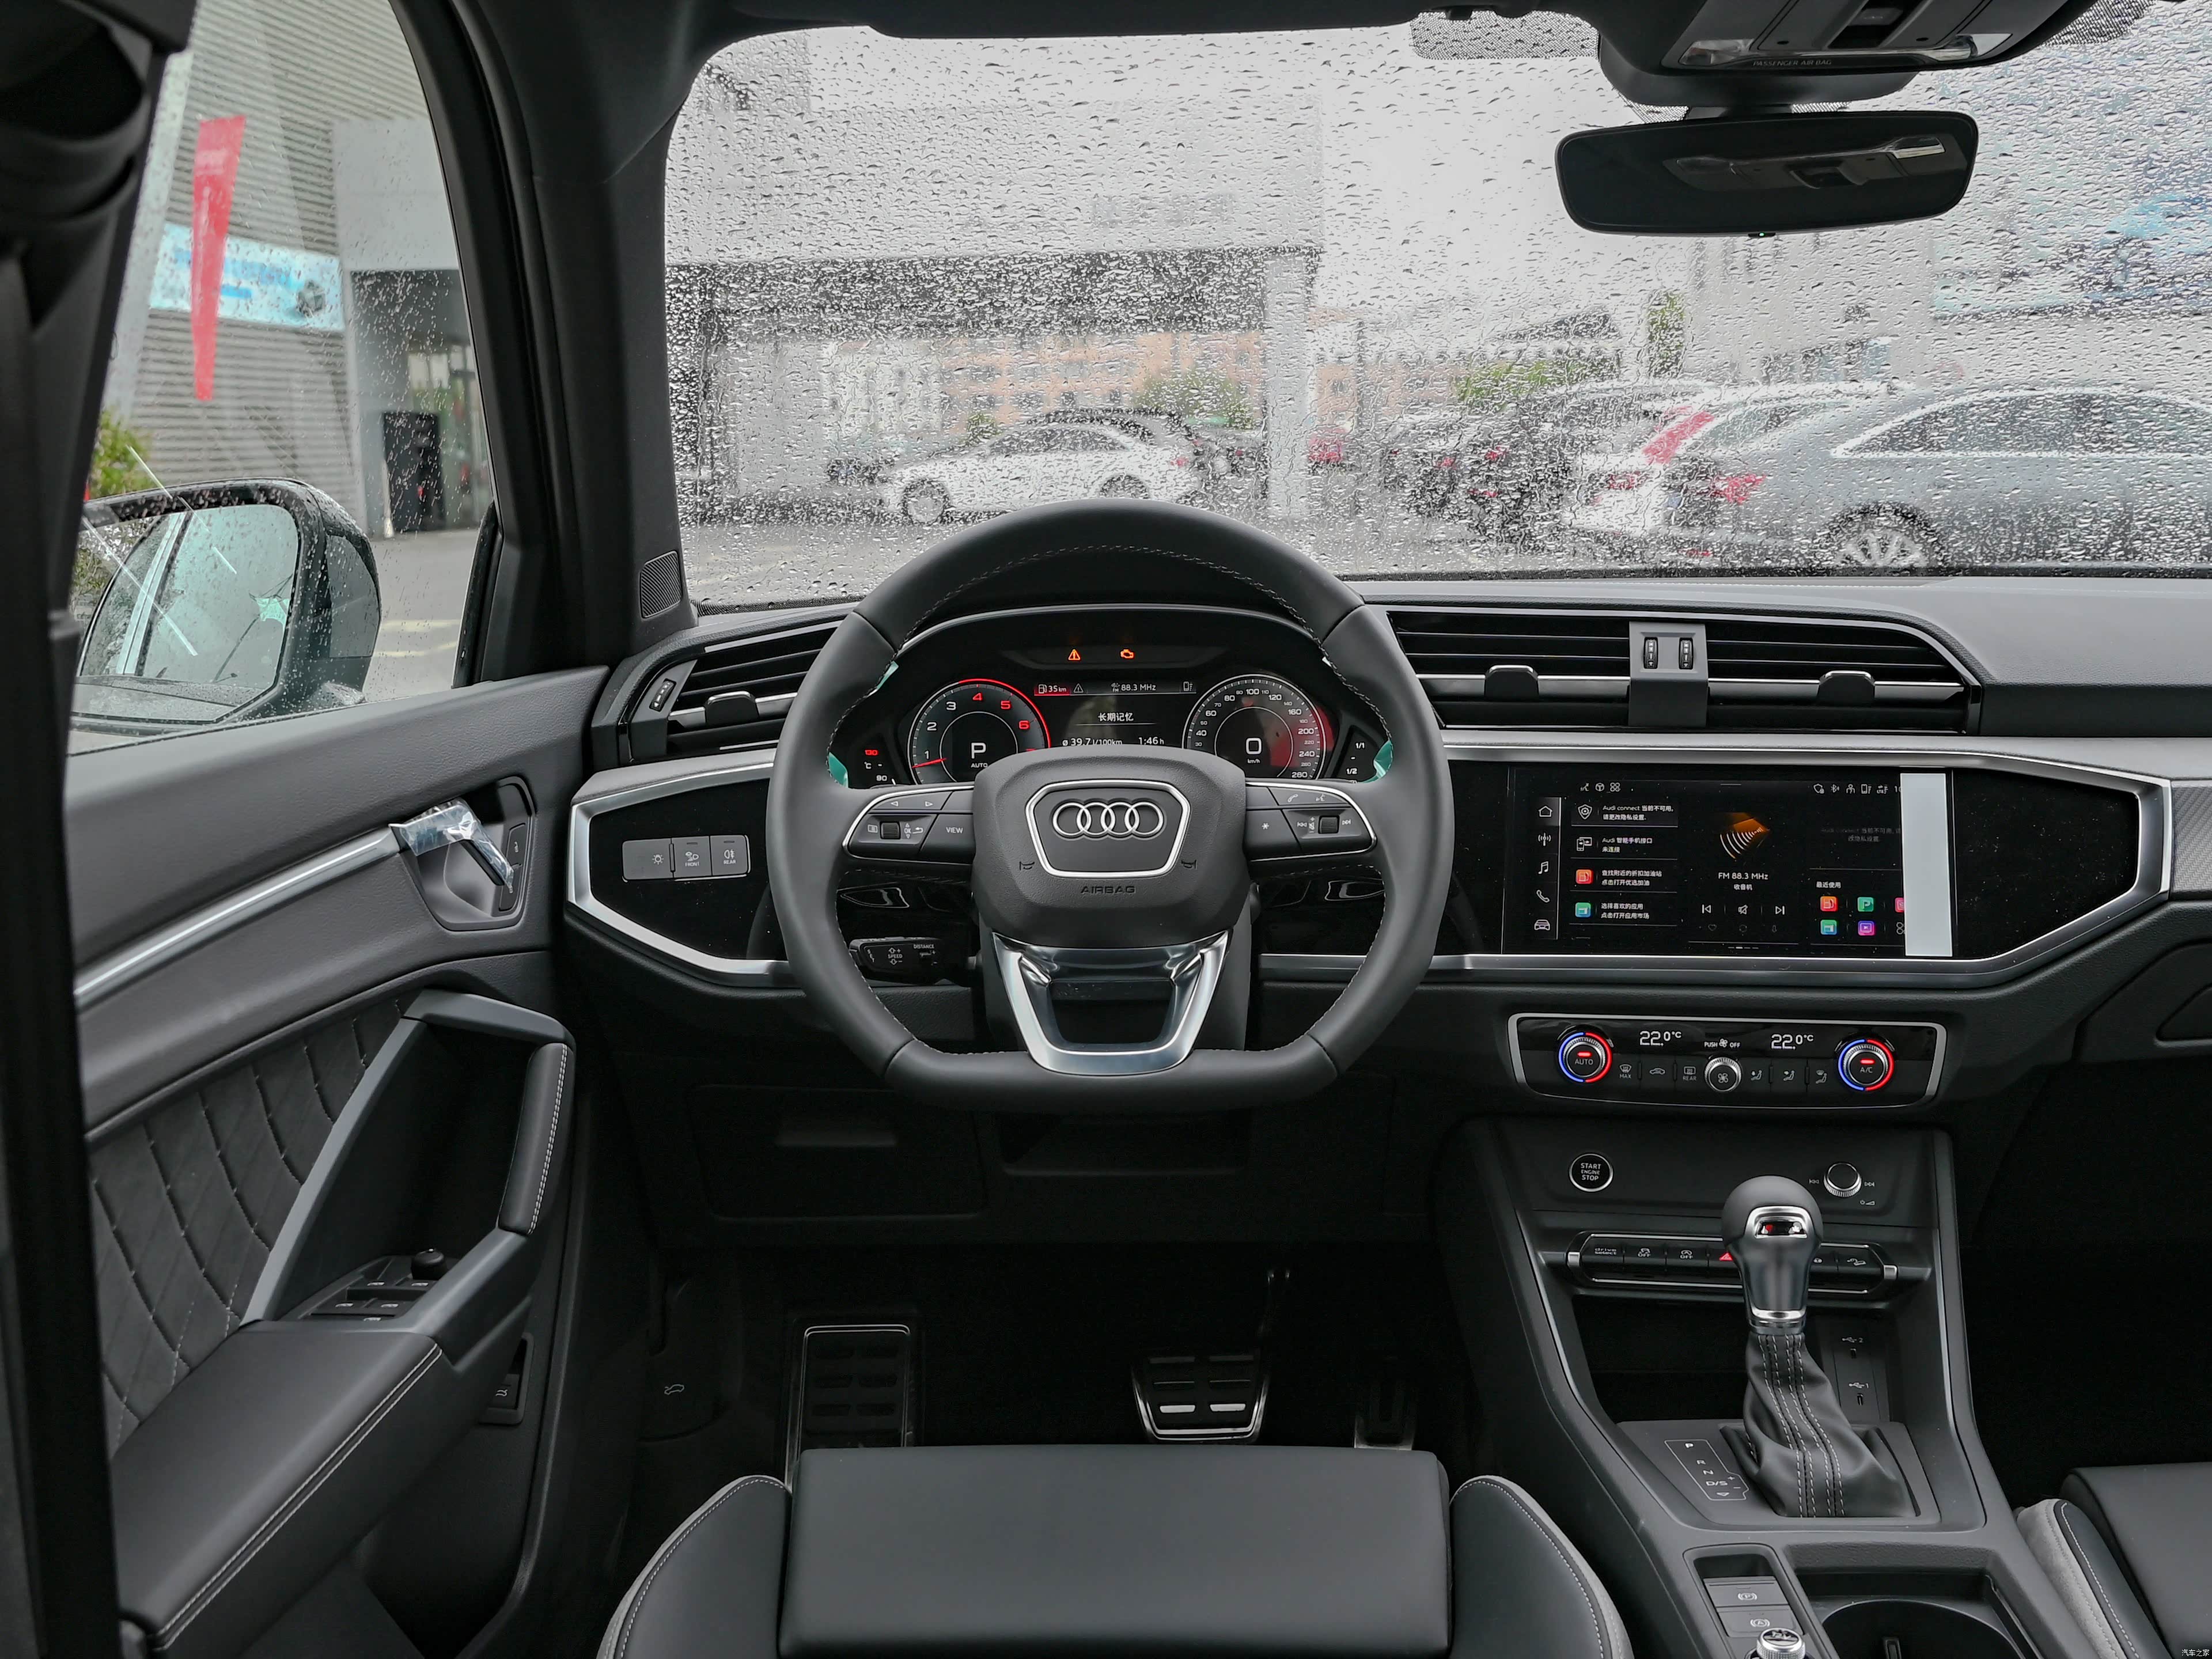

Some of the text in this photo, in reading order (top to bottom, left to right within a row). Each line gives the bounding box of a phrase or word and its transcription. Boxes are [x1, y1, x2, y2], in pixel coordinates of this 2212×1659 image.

[972, 692, 983, 701] 4
[946, 701, 957, 710] 3
[1000, 700, 1012, 709] 5
[1098, 712, 1134, 722] 长期记忆
[926, 722, 937, 731] 2
[1018, 720, 1030, 730] 6
[1070, 737, 1091, 747] 39.7
[1138, 737, 1165, 745] 1:46 h
[971, 742, 987, 759] P
[1245, 737, 1262, 755] 0
[924, 750, 930, 759] 1
[1081, 885, 1136, 894] AIRBAG
